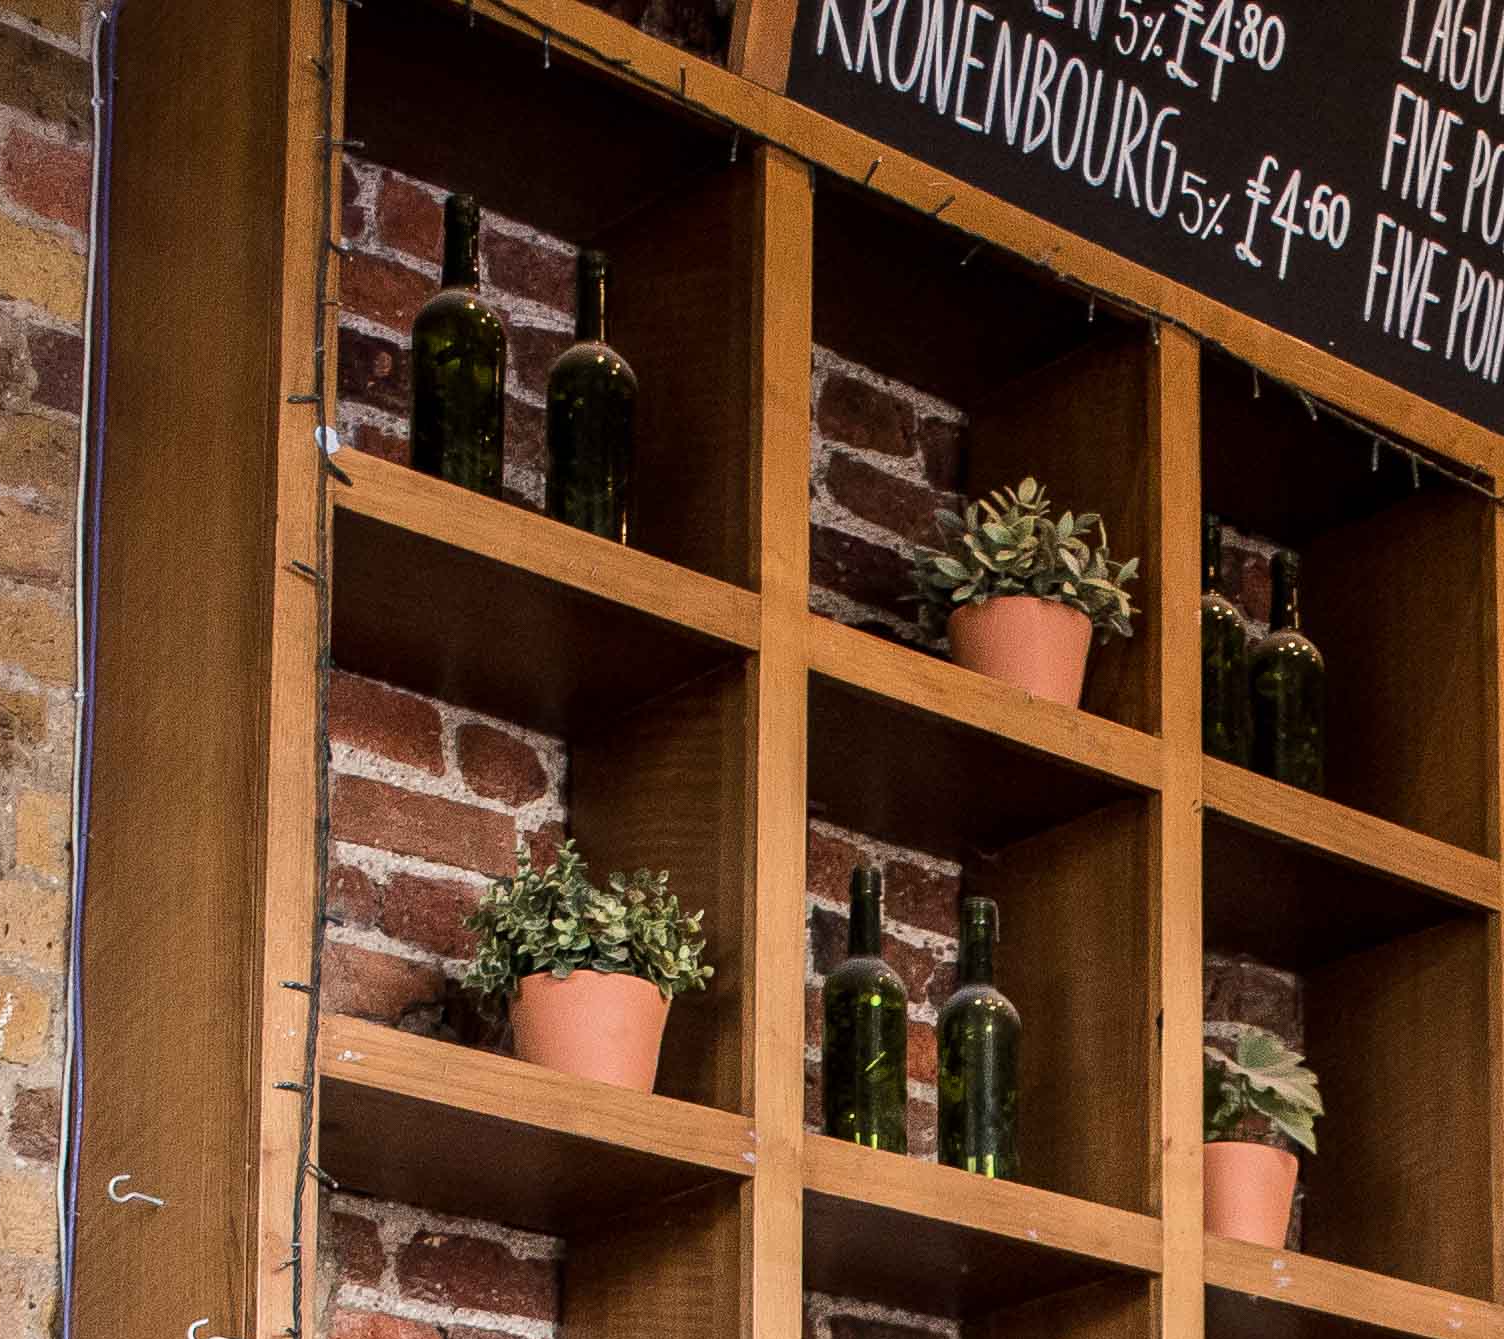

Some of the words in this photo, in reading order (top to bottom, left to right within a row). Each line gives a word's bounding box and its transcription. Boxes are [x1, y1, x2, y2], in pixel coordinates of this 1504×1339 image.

[817, 0, 1181, 217] KRONENBOURG
[1179, 171, 1231, 239] 5%
[1235, 156, 1351, 280] £4.60
[1382, 83, 1463, 223] FIVE
[1364, 213, 1448, 352] FIVE
